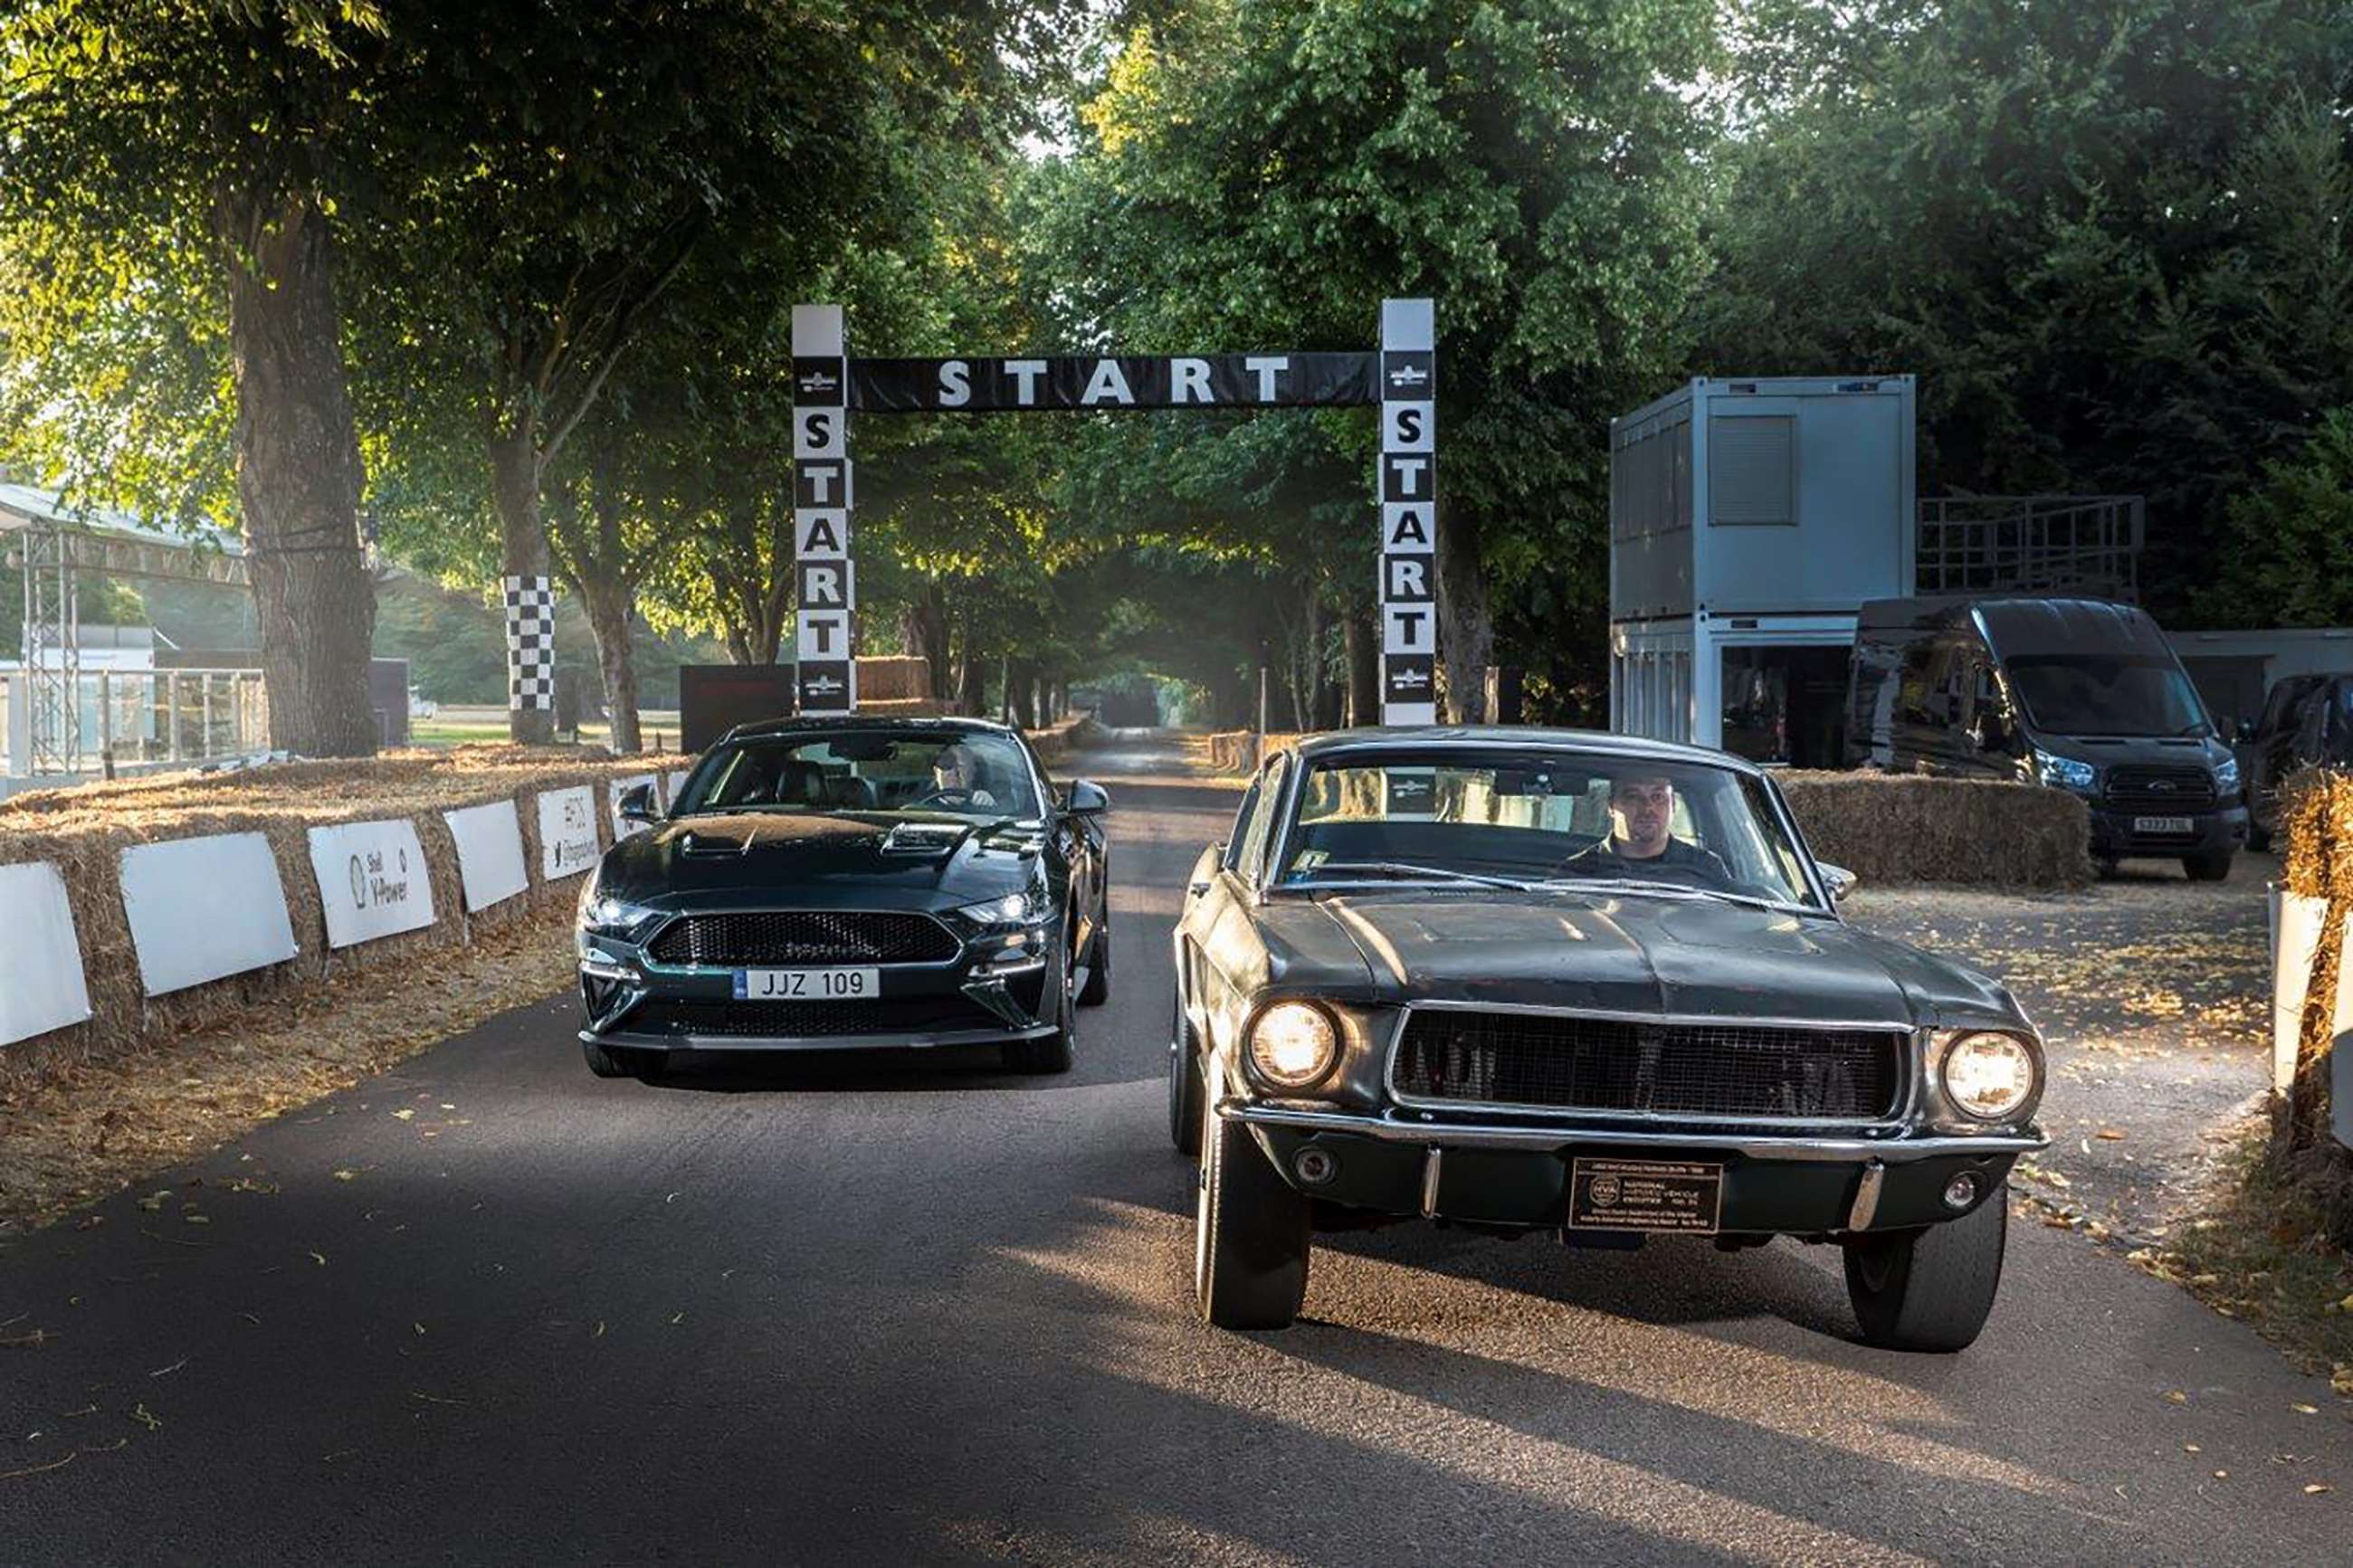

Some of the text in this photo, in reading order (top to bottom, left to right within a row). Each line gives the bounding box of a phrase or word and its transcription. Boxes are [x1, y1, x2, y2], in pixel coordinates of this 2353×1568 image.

[938, 356, 1289, 406] START
[803, 413, 842, 653] START
[1391, 409, 1427, 645] START
[762, 972, 862, 995] JJZ 109
